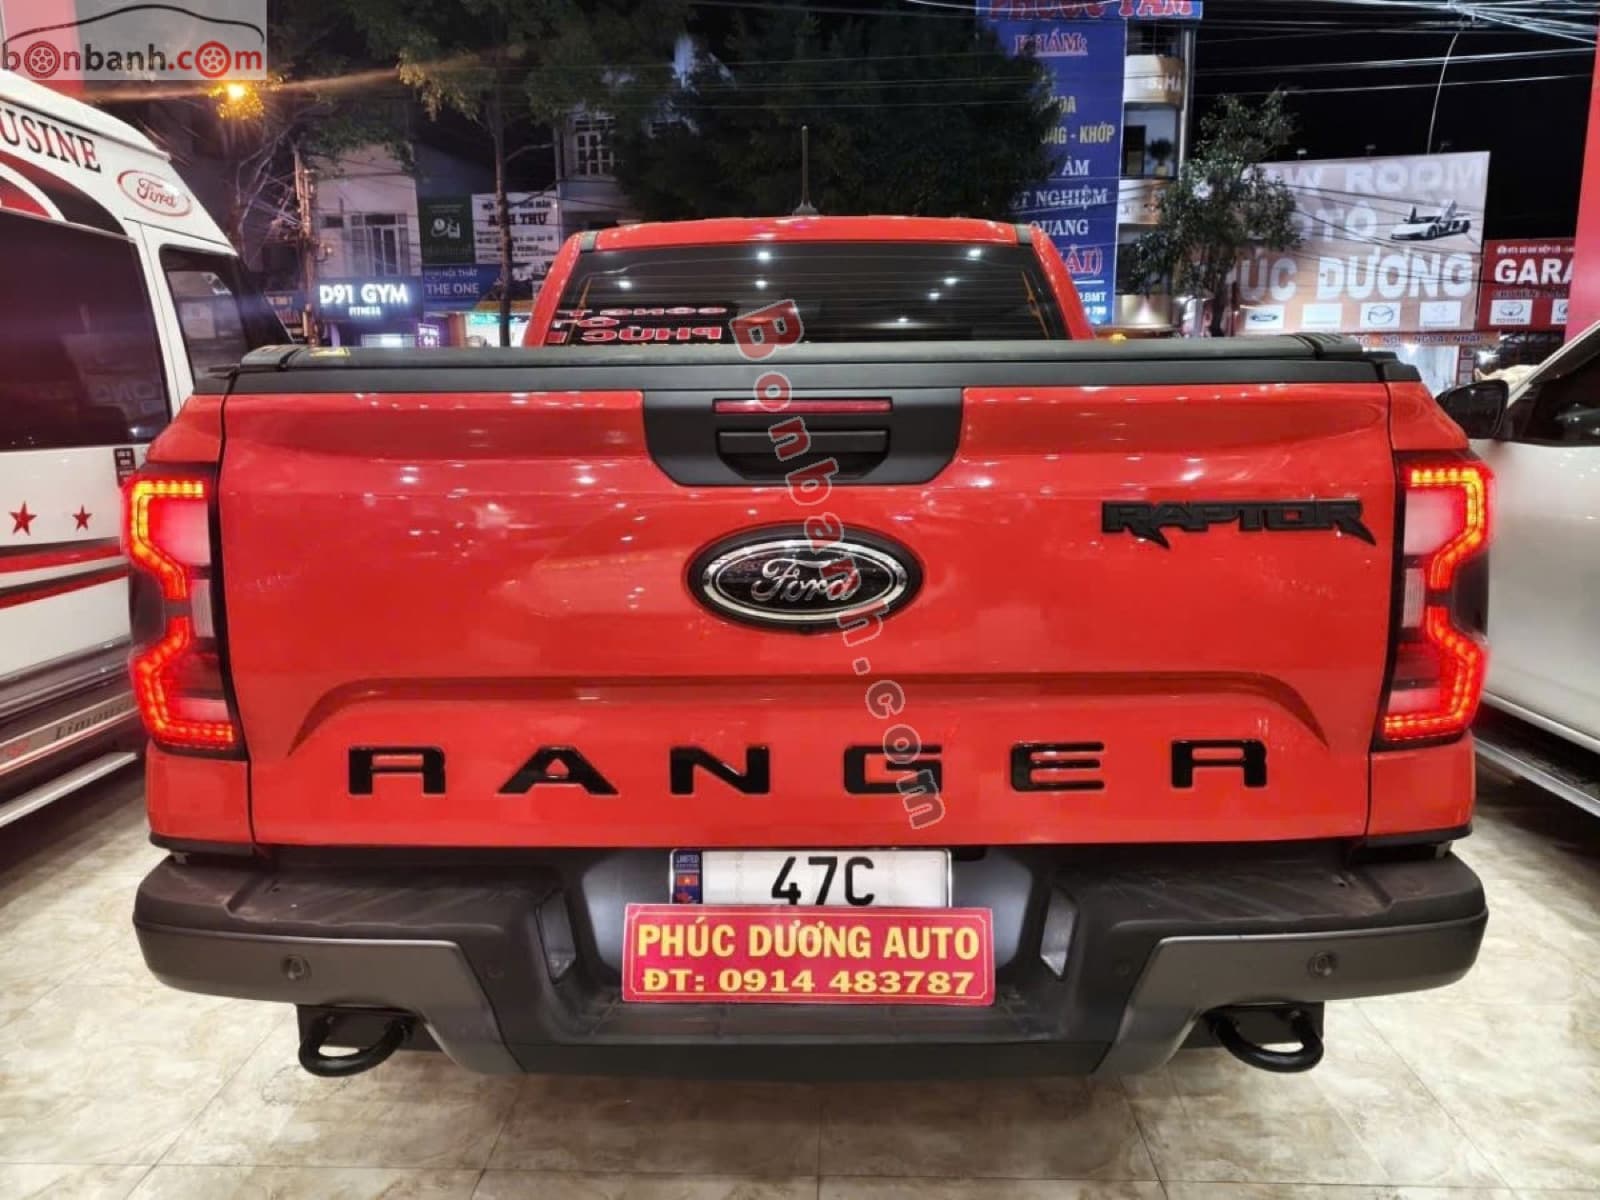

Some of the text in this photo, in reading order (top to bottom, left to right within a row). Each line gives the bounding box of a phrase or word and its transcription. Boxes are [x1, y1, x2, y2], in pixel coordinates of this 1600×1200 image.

[0, 107, 102, 174] USINE
[1079, 121, 1116, 143] KHỚP
[136, 177, 177, 209] Ford
[1345, 158, 1481, 194] ROOM
[1035, 184, 1109, 210] NGHIỆM
[361, 283, 408, 304] GYM
[424, 283, 480, 296] THE ONE
[1102, 500, 1377, 549] RAPTOR
[751, 558, 858, 601] Ford
[348, 738, 1268, 795] RANGER
[770, 856, 875, 905] 47C
[638, 916, 980, 960] PHÚC DƯƠNG AUTO
[643, 967, 975, 995] ĐT: 0914 483787
